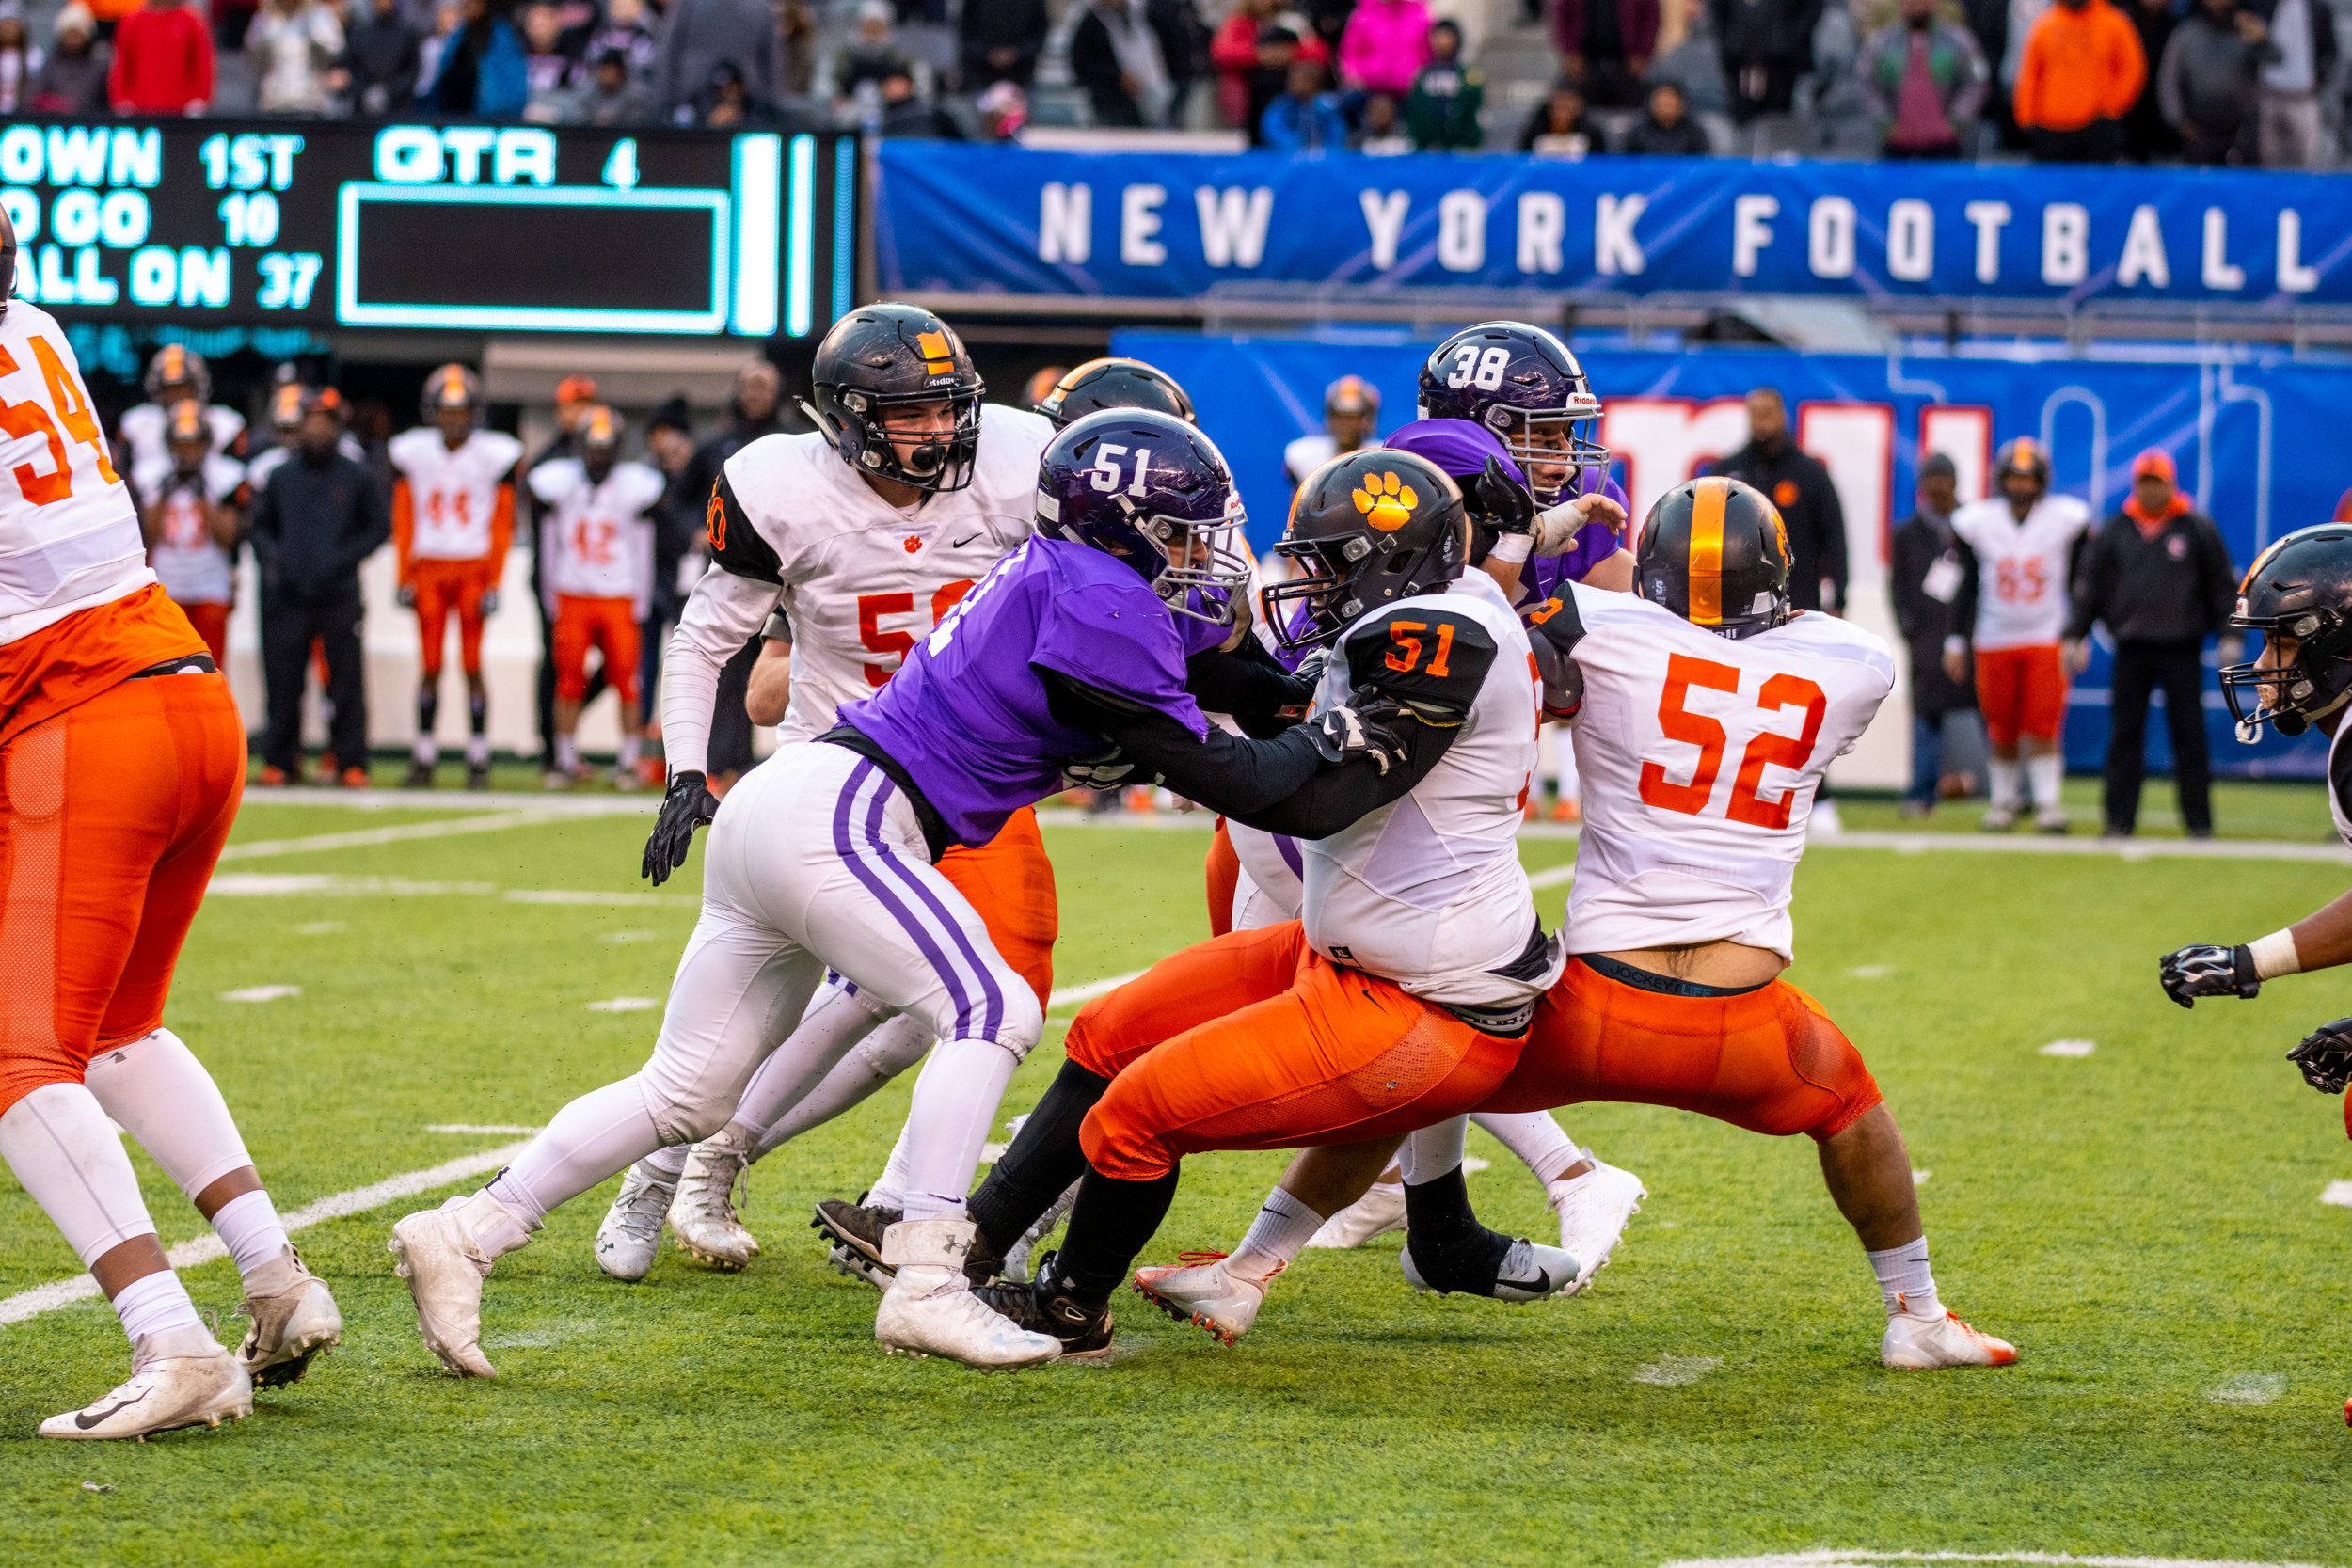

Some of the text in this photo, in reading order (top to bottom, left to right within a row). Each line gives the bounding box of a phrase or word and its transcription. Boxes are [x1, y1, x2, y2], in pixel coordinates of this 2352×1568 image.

[199, 133, 306, 191] 1ST
[375, 126, 638, 189] QTR 4
[51, 187, 151, 248] GO
[217, 190, 280, 247] 10
[1038, 182, 2321, 292] NEW YORK FOOTBALL
[129, 245, 231, 308] ON
[256, 252, 324, 309] 37
[1447, 345, 1512, 392] 38
[1090, 442, 1152, 498] 51
[426, 483, 471, 529] 44
[1384, 621, 1454, 677] 51
[1638, 652, 1827, 830] 52
[1609, 965, 1713, 997] JOCKEY LIFE
